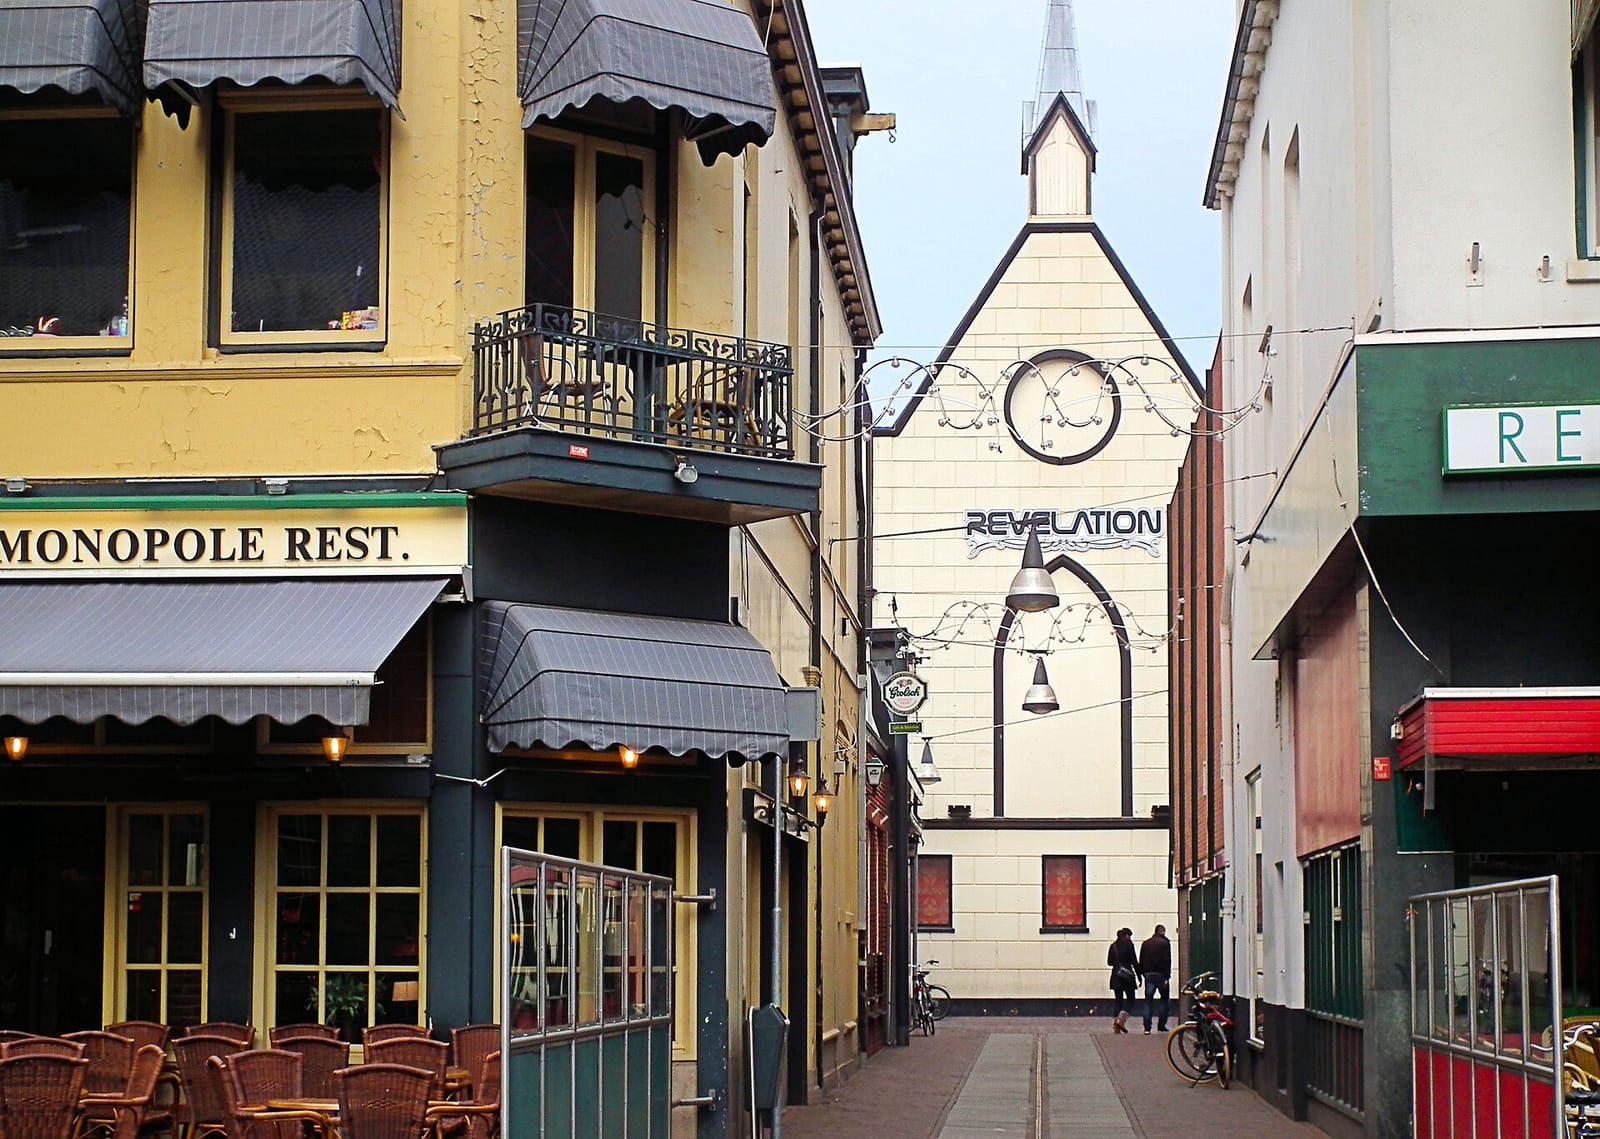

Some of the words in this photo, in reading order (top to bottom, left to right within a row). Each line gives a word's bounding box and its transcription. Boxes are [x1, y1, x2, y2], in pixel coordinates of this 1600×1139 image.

[966, 510, 1162, 536] REVELATION
[0, 528, 265, 563] MONOPOLE
[284, 526, 410, 562] REST.
[889, 686, 921, 699] Grolsch
